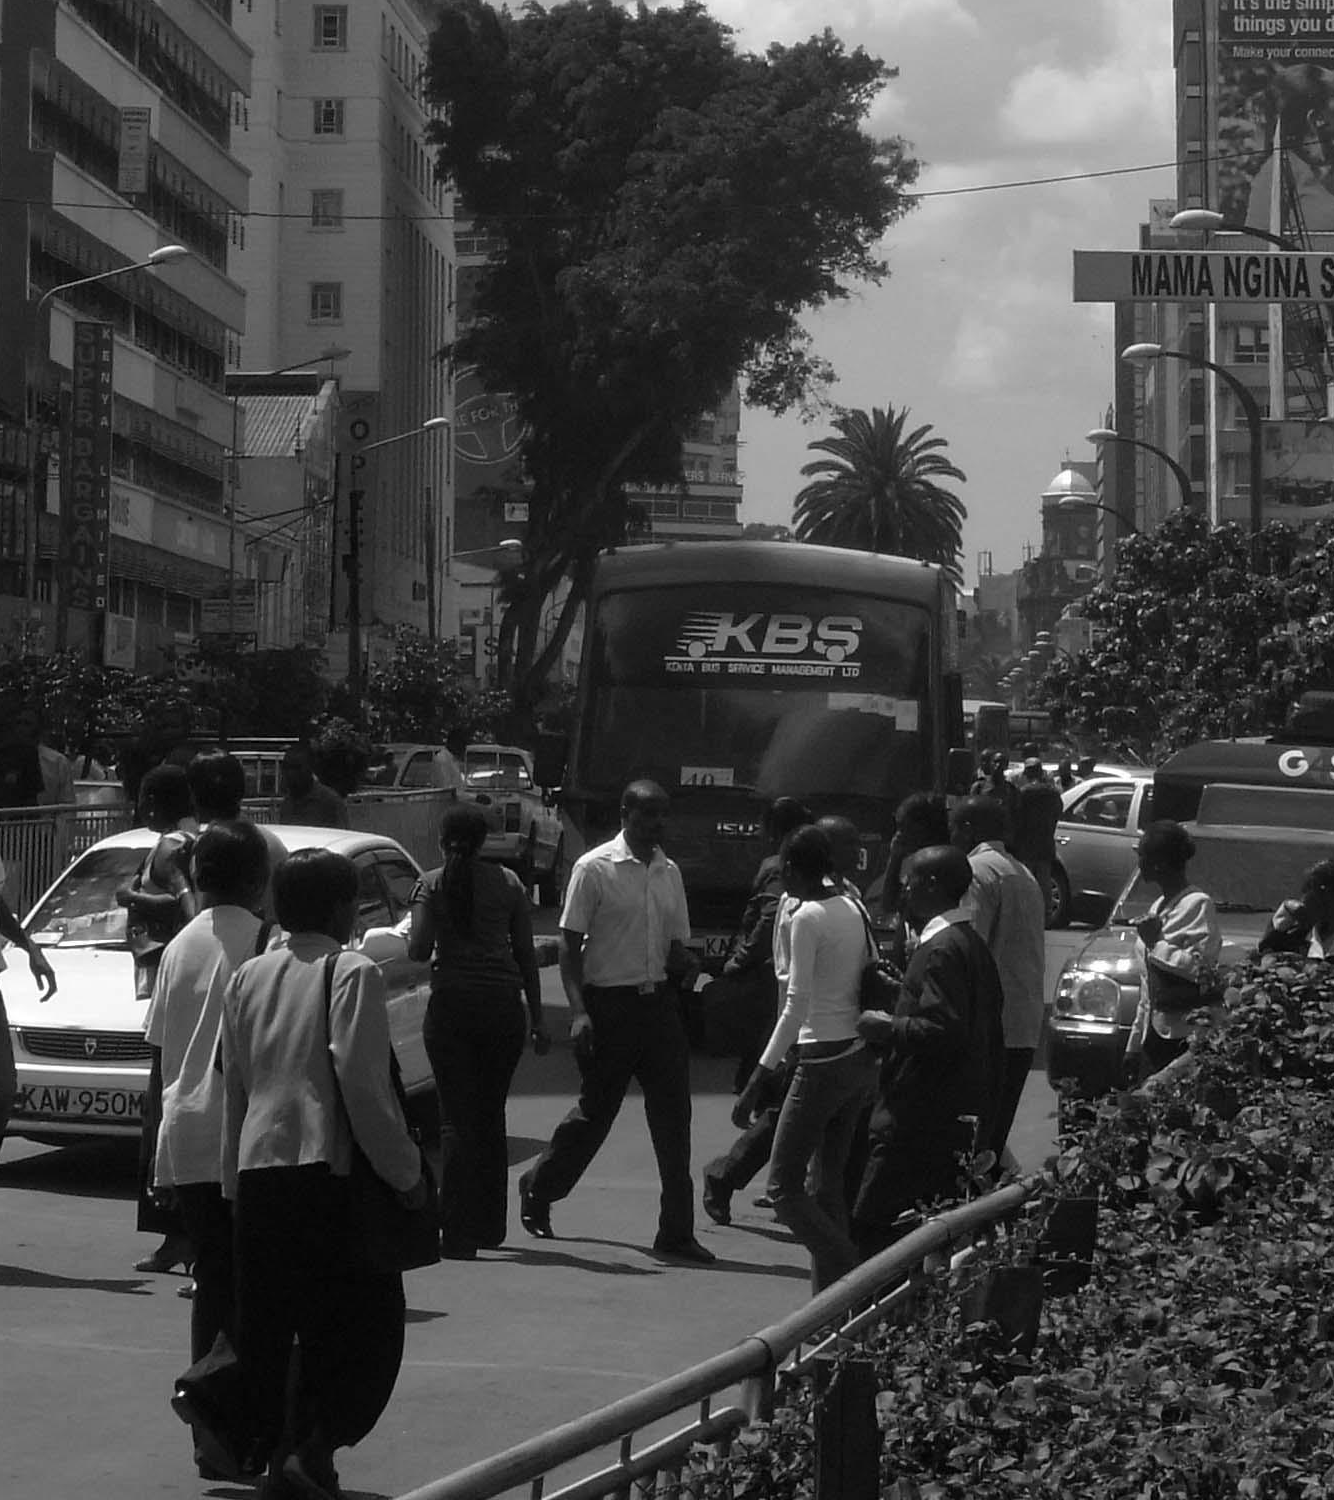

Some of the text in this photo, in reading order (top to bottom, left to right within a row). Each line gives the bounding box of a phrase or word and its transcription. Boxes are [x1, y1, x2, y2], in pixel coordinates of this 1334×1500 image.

[1234, 14, 1286, 36] things
[1289, 18, 1321, 36] you
[1233, 47, 1264, 59] Make
[1267, 49, 1292, 61] your
[1132, 254, 1214, 297] MAMA
[1224, 256, 1311, 298] NGINA
[95, 326, 112, 609] KENYA LIMITED
[705, 612, 862, 660] KBS
[701, 663, 721, 675] BUS
[727, 663, 765, 676] SERVICE
[771, 664, 835, 677] MANAGEMENT
[841, 666, 860, 678] LTD
[23, 1088, 143, 1116] KAW 950M
